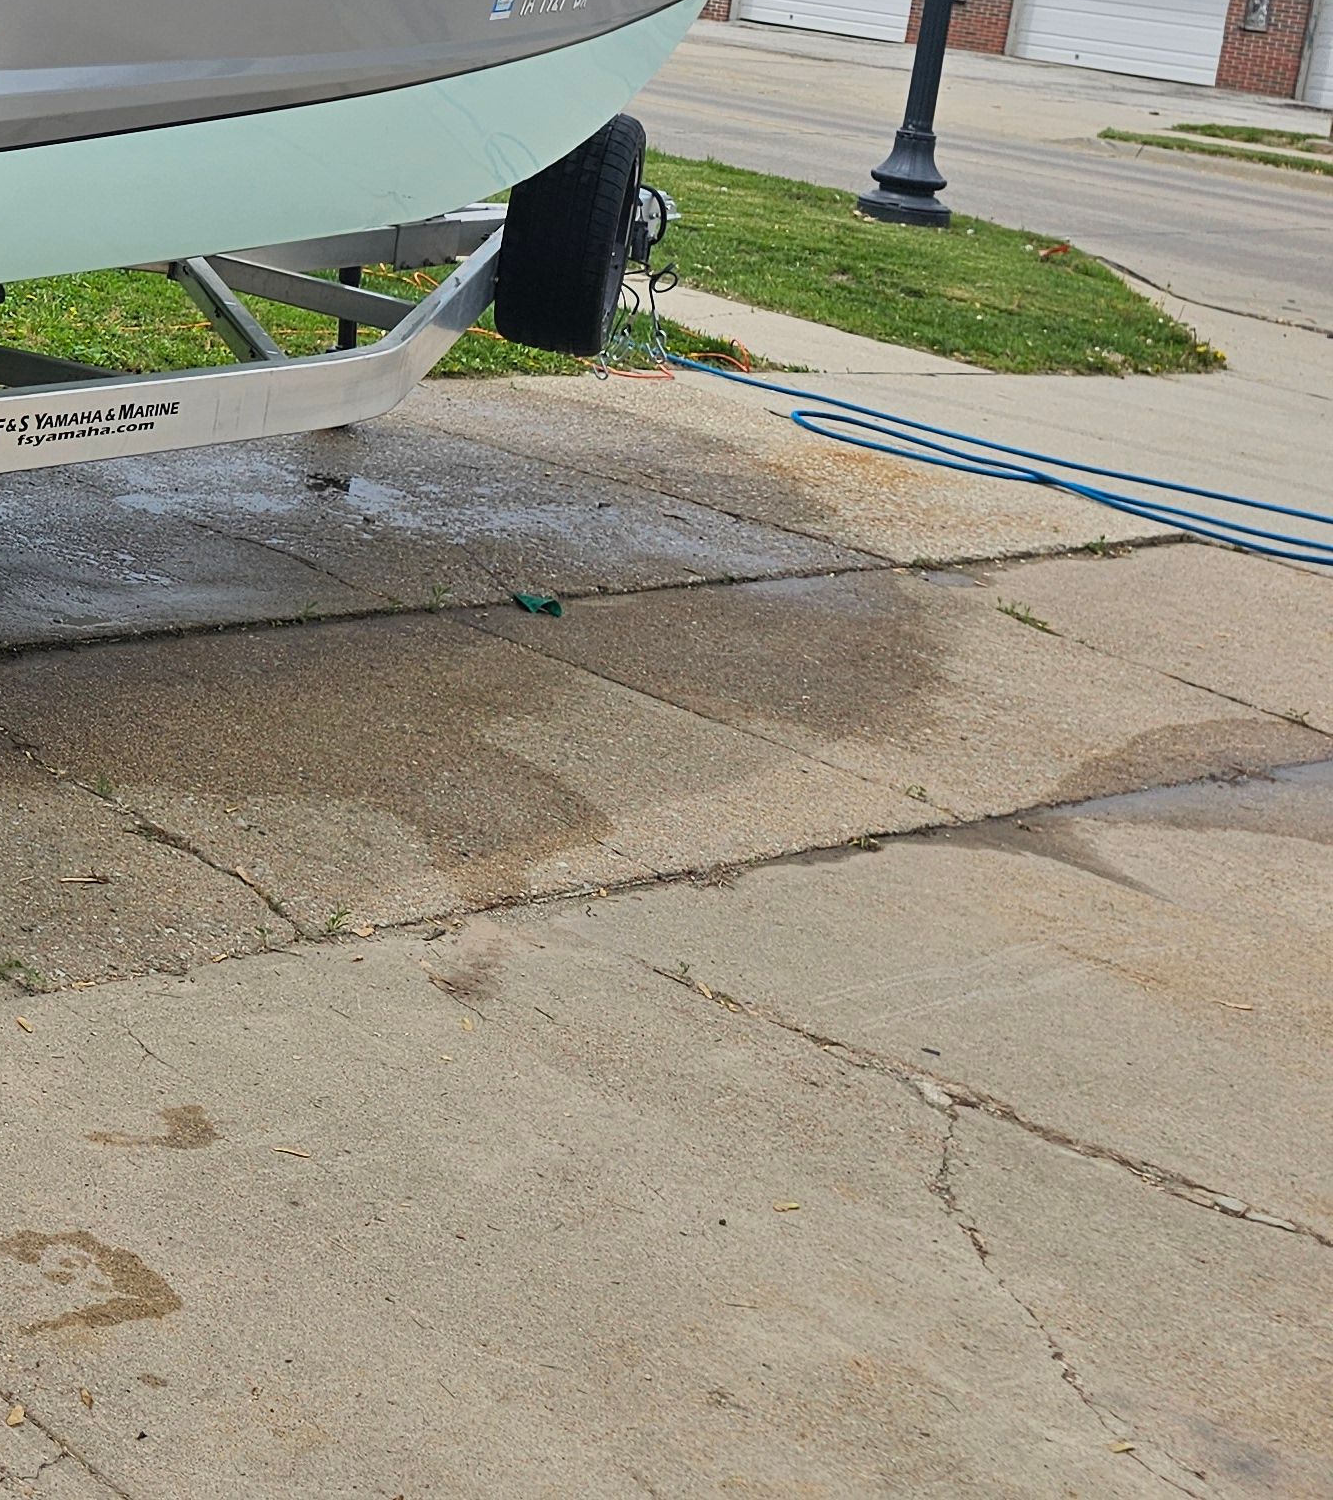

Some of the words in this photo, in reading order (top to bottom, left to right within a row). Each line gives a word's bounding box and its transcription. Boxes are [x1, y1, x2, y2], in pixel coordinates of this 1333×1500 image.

[34, 409, 103, 430] YAMAHA
[106, 408, 116, 422] &
[118, 402, 180, 420] MARINE
[17, 421, 155, 446] fsyamaha.com
